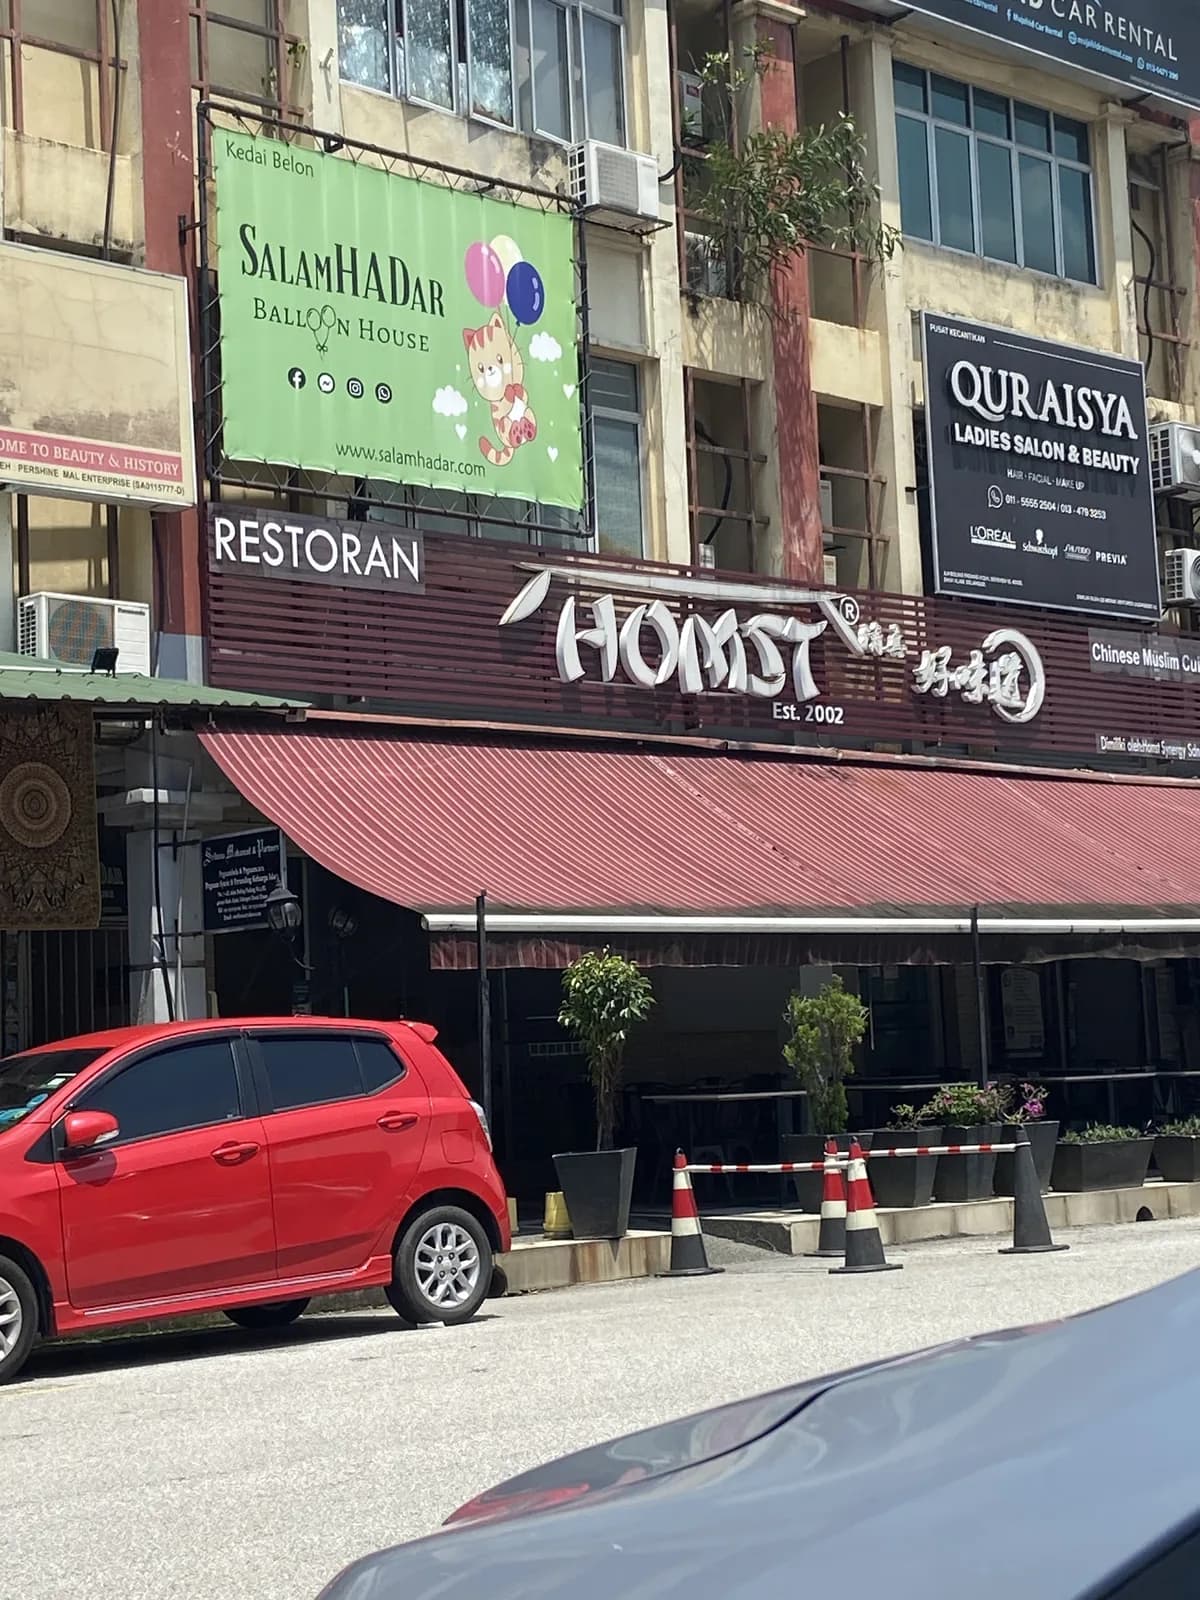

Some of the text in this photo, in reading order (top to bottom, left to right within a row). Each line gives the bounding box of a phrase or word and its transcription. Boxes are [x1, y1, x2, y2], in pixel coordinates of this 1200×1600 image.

[1051, 0, 1178, 61] CAR RENTAL
[226, 139, 314, 178] Kedai Belon
[358, 318, 430, 352] HOUSE
[951, 360, 1138, 440] QURAISYA
[30, 442, 49, 457] TO
[54, 446, 104, 465] BEAUTY
[108, 454, 120, 468] &
[124, 457, 179, 476] HISTORY
[335, 442, 486, 478] www.salamhadar.com
[954, 422, 1140, 475] LADIES SALON & BEAUTY
[18, 463, 59, 478] PERSHINE
[63, 471, 80, 481] MAL
[82, 472, 130, 488] ENTERPRISE
[1007, 468, 1023, 480] HAIR
[1056, 478, 1075, 489] MAKE
[1075, 481, 1085, 490] UP
[215, 516, 420, 583] RESTORAN
[1096, 550, 1126, 565] PREVIA
[1092, 643, 1140, 665] Chinese
[1143, 648, 1180, 671] Muslim
[772, 702, 844, 725] Est. 2002
